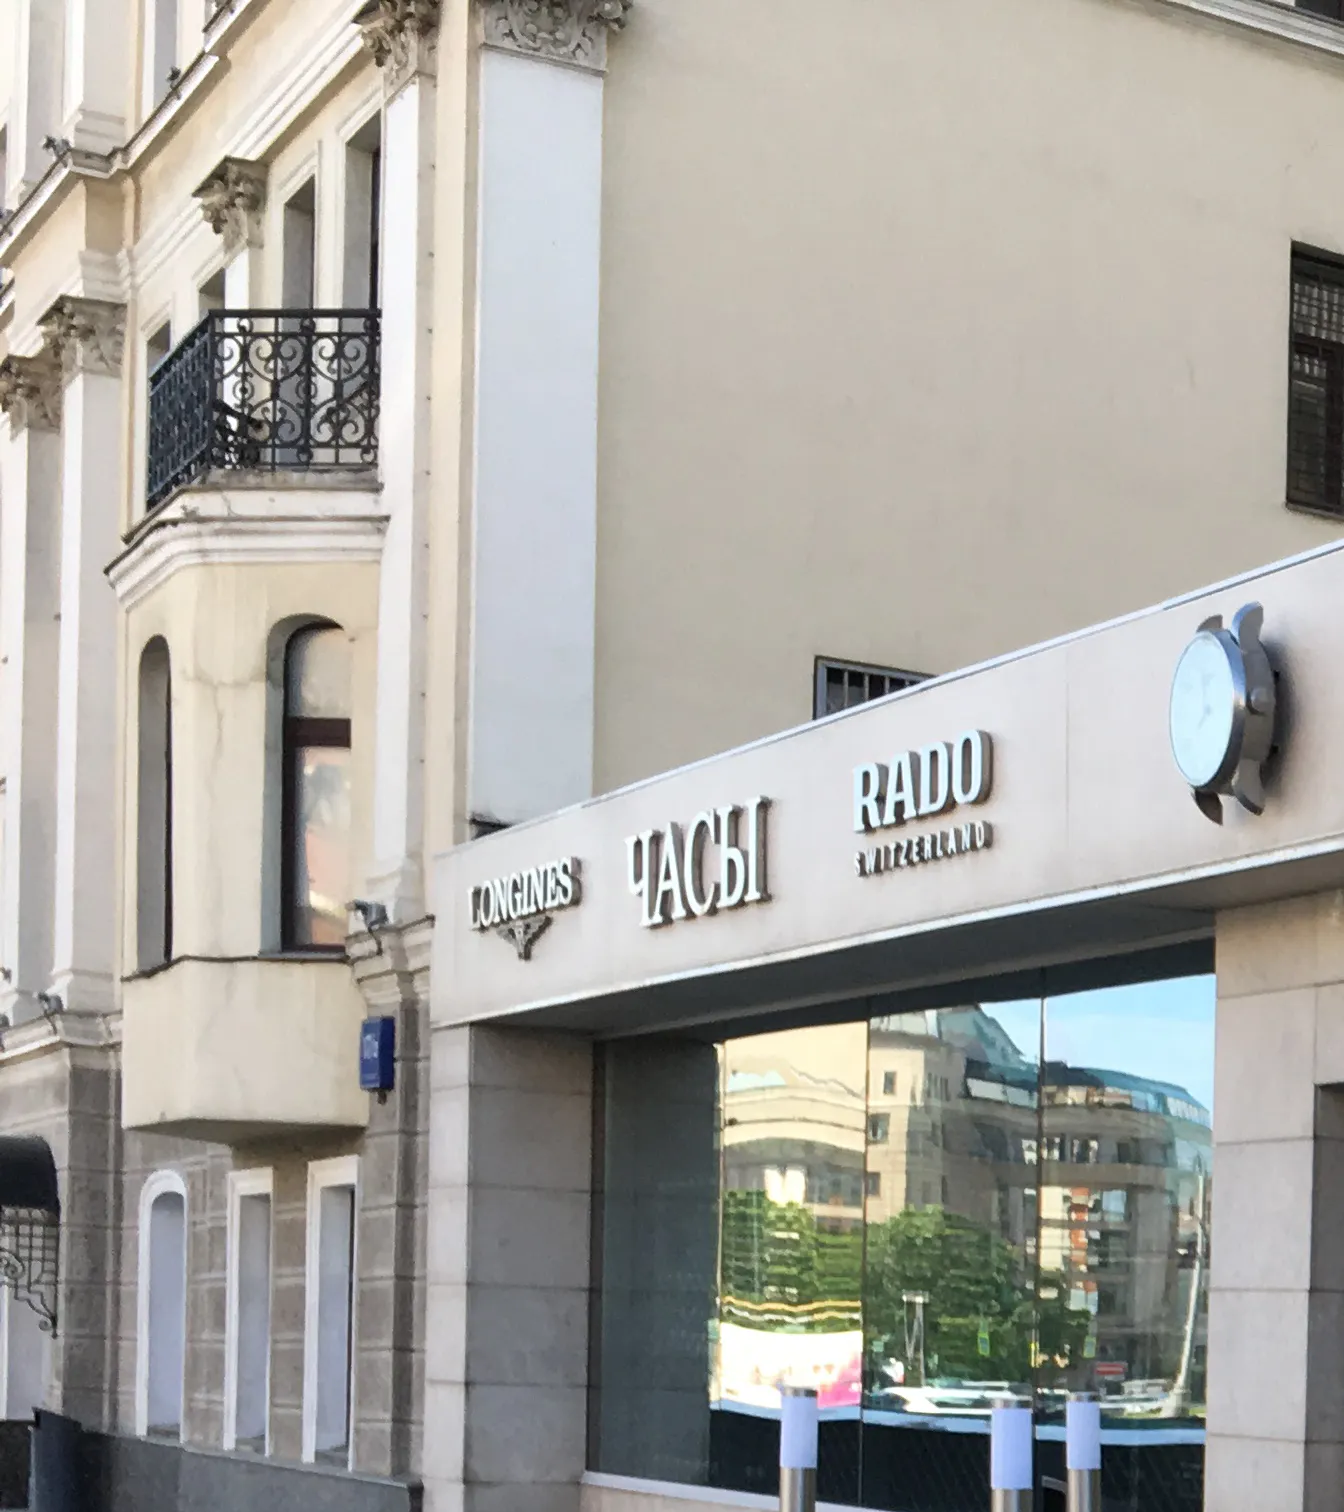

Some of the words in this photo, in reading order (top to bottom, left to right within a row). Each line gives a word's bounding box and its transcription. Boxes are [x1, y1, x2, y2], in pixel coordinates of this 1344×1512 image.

[852, 728, 993, 834] RADO
[467, 856, 583, 931] LONGINES
[624, 795, 773, 928] ЧАСЫ
[854, 820, 993, 877] SWITZERLAND
